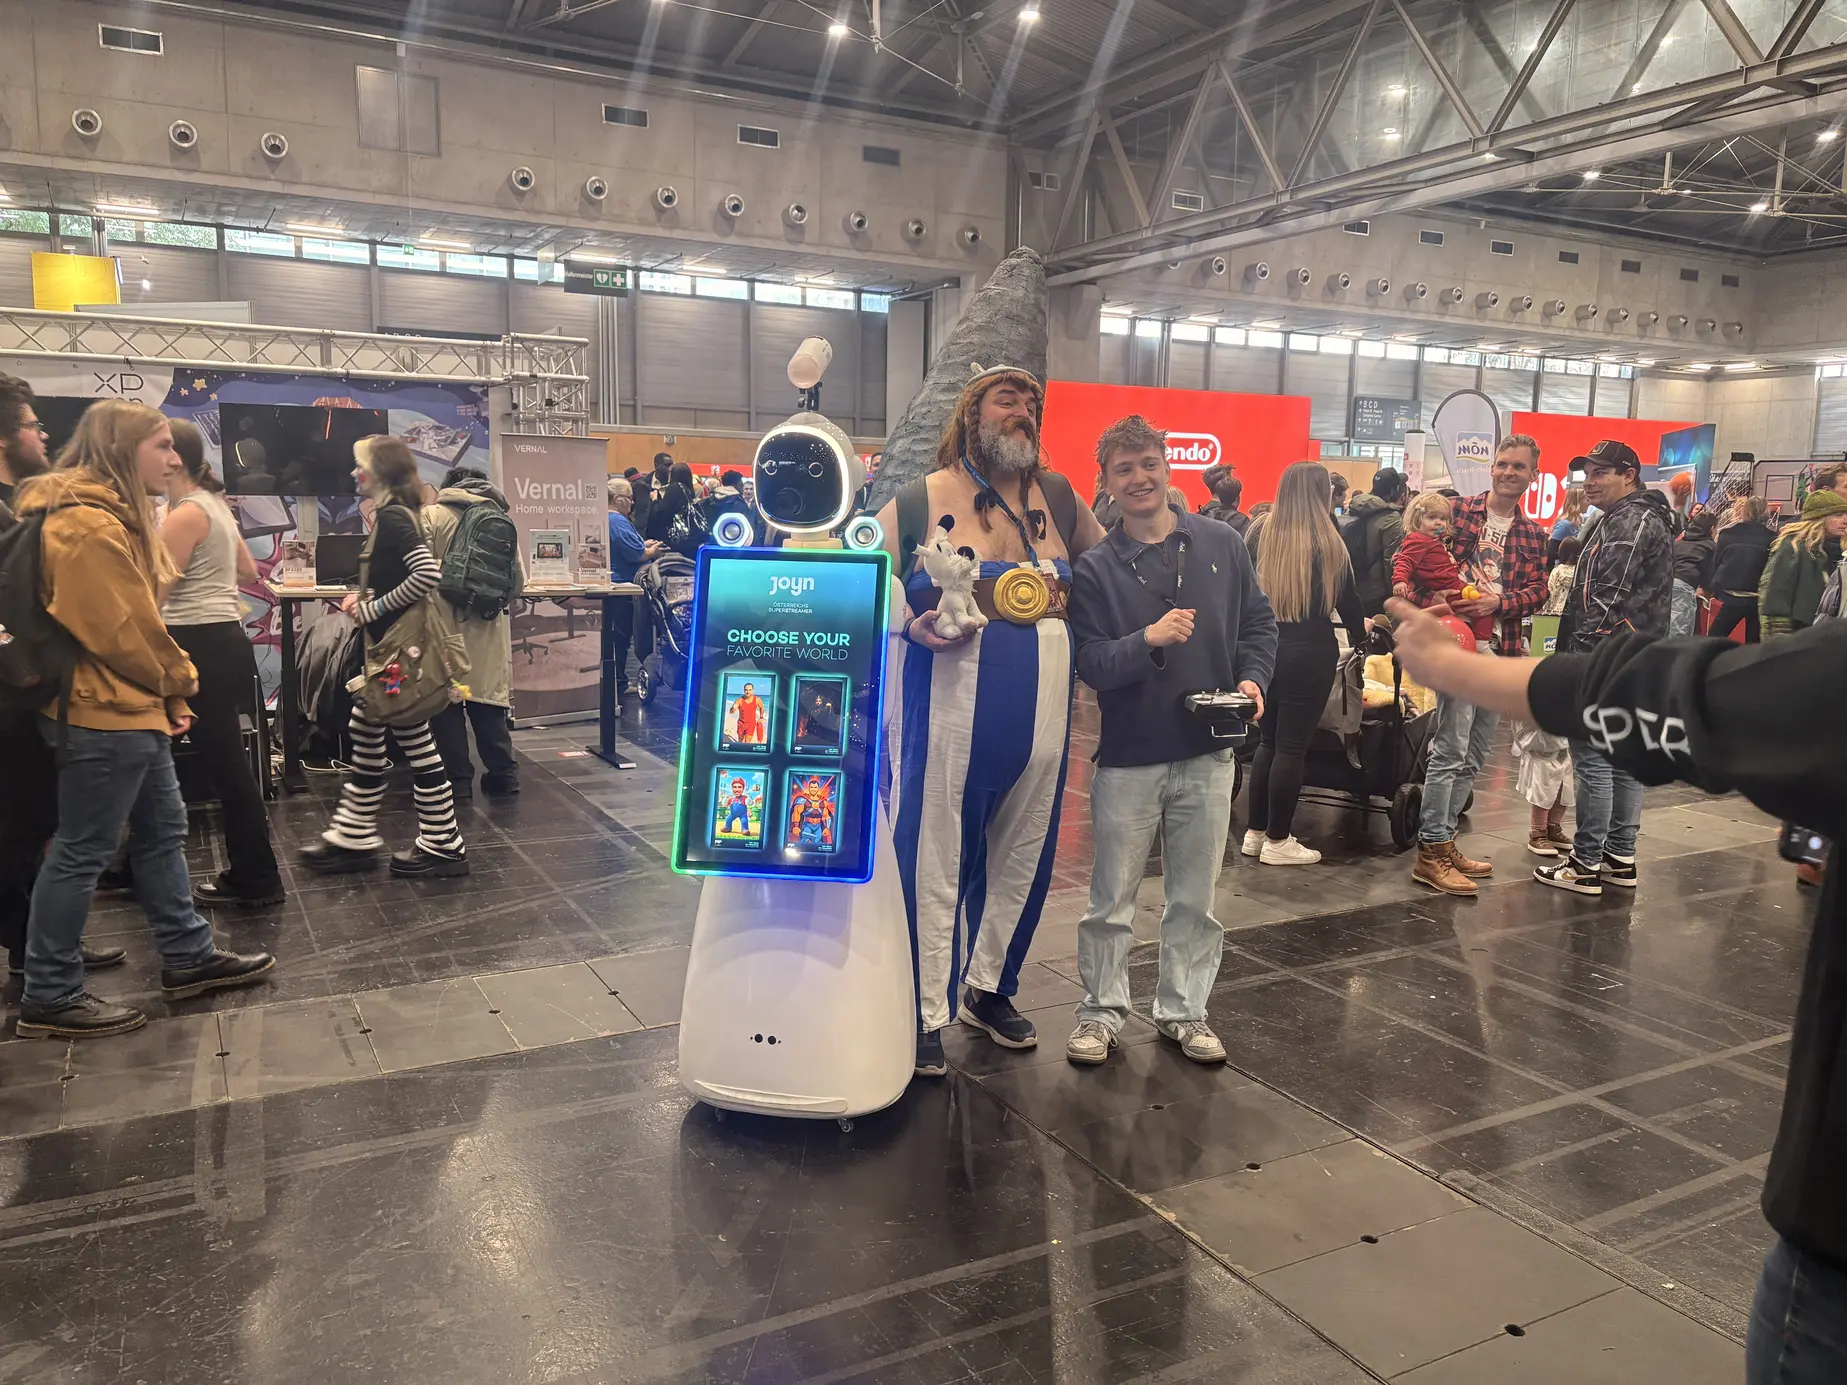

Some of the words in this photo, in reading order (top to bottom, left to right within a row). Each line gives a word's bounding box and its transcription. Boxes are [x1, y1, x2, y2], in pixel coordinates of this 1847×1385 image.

[93, 372, 144, 395] XP
[514, 445, 548, 454] VERNAL
[514, 477, 583, 500] Vernal
[515, 504, 544, 514] Home
[727, 628, 800, 645] CHOOSE
[803, 631, 851, 647] YOUR
[726, 644, 793, 659] FAVORITE
[796, 647, 849, 661] WORLD
